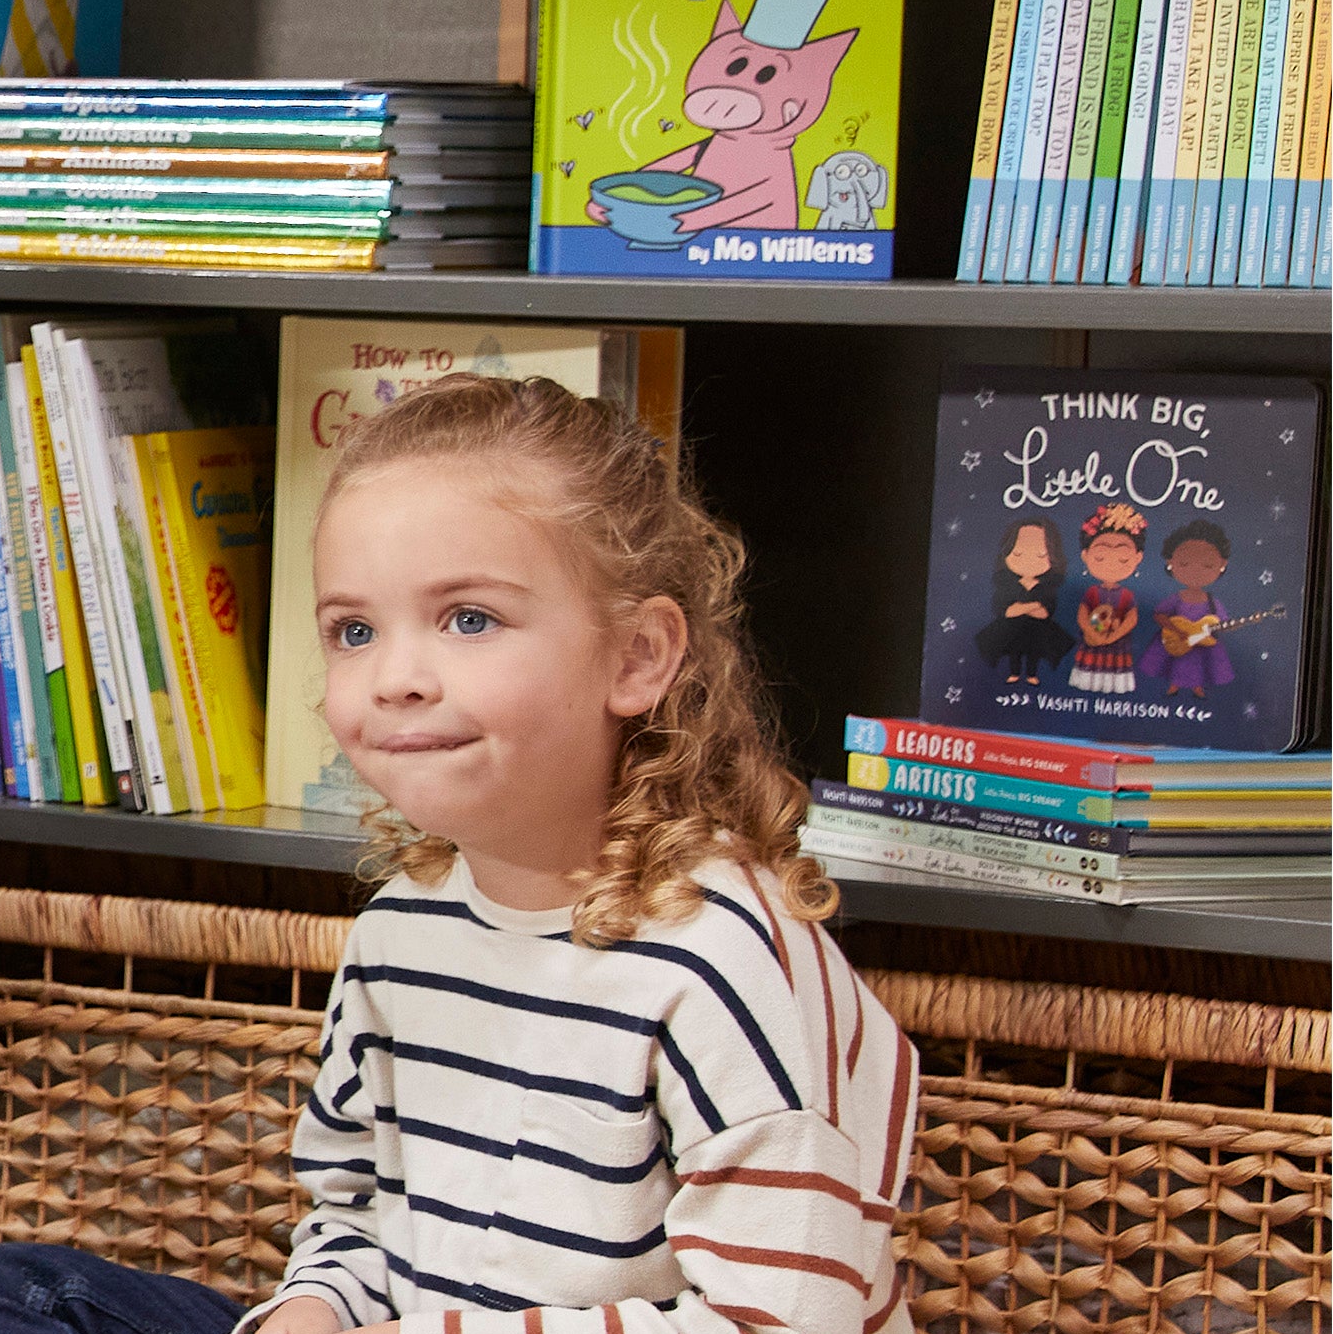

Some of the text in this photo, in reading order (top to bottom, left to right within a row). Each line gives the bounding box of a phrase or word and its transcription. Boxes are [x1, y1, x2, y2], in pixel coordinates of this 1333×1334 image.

[989, 19, 1009, 72] THANK
[1116, 19, 1131, 43] I'M
[1140, 30, 1155, 54] AM
[1215, 5, 1233, 67] INVITED
[1241, 16, 1259, 51] ARE
[1264, 32, 1278, 51] TO
[1287, 11, 1305, 81] SURPRISE
[1061, 43, 1079, 69] MY
[1084, 18, 1106, 89] FRIEND
[1161, 1, 1188, 135] HAPPY PIG DAY!
[1187, 45, 1204, 89] TAKE
[1239, 58, 1254, 73] IN
[1261, 58, 1276, 80] MY
[984, 79, 1000, 109] YOU
[1054, 77, 1074, 119] NEW
[1107, 66, 1125, 117] FROG!
[1133, 61, 1152, 118] GOING!
[1212, 73, 1226, 92] TO
[1285, 87, 1298, 107] MY
[1081, 95, 1096, 112] IS
[58, 120, 193, 143] Dinosaurs
[977, 118, 995, 163] BOOK
[1075, 119, 1093, 156] SAD
[1181, 111, 1197, 151] NAP!
[1204, 113, 1222, 169] PARTY!
[1232, 97, 1250, 150] BOOK!
[1254, 85, 1273, 164] TRUMPET!
[1279, 113, 1296, 171] FRIEND!
[1047, 127, 1067, 169] TOY!
[688, 236, 874, 265] By Mo Willems
[351, 343, 455, 371] HOW TO
[1041, 392, 1210, 438] THINK BIG,
[1003, 426, 1225, 511] Little One
[28, 498, 43, 517] You
[36, 557, 51, 591] Mouse
[42, 605, 57, 641] Cookie
[1036, 693, 1169, 718] VASHTI HARRISON
[896, 729, 977, 764] LEADERS
[894, 764, 977, 802] ARTISTS
